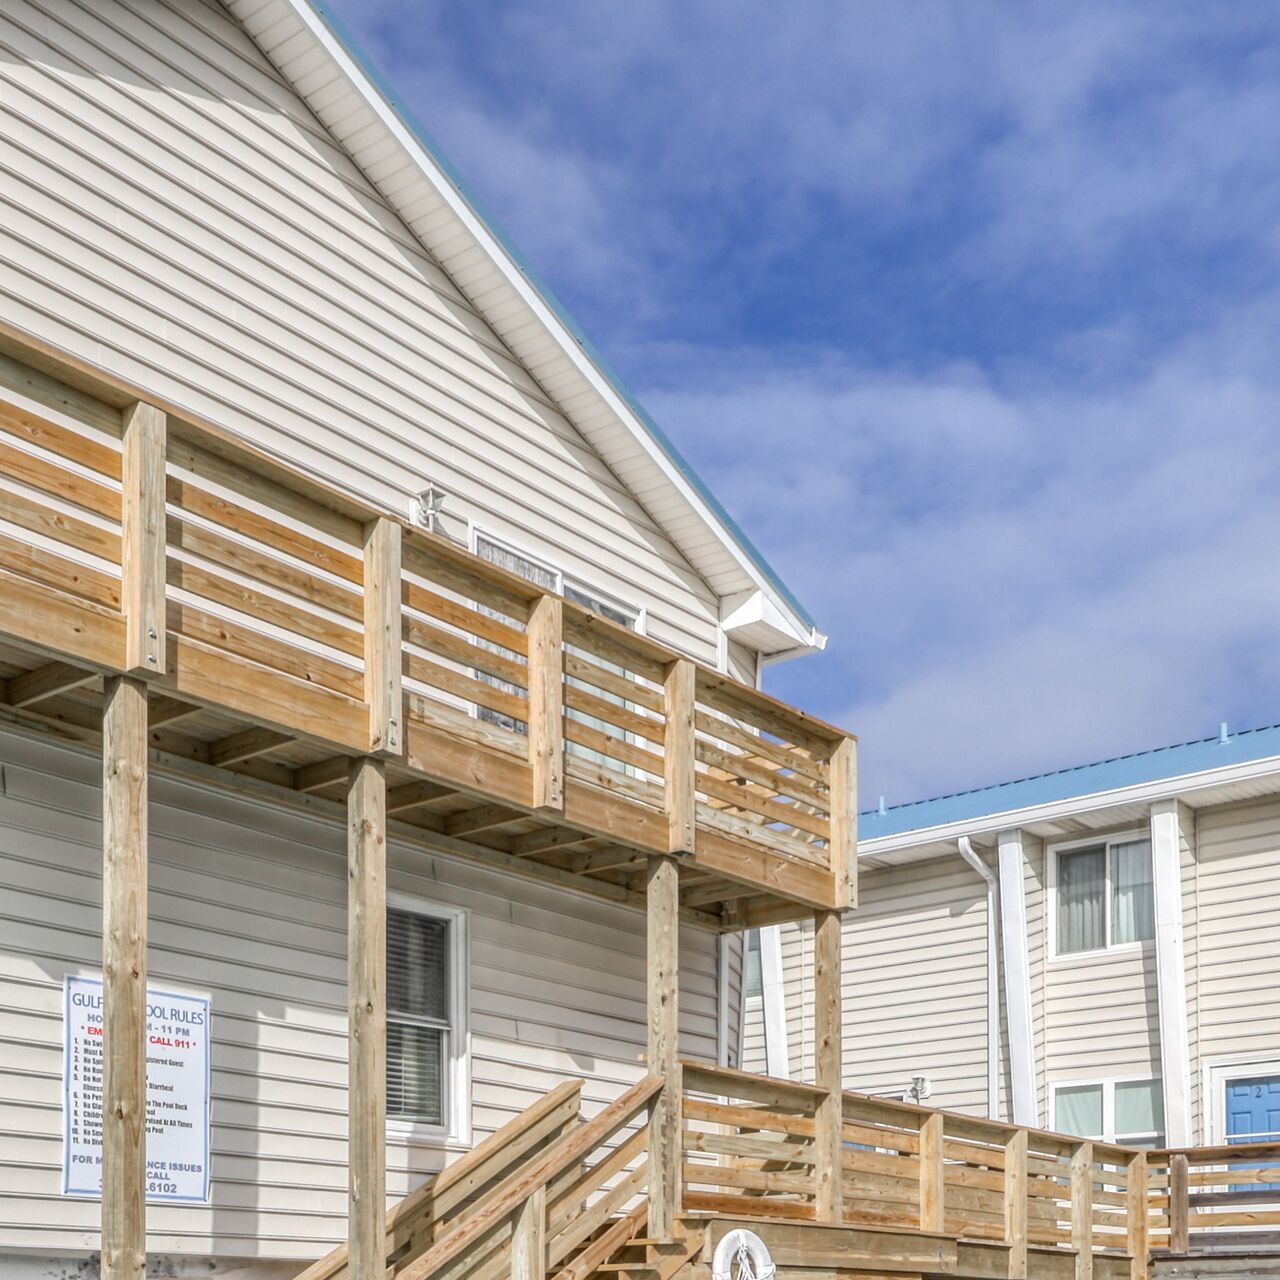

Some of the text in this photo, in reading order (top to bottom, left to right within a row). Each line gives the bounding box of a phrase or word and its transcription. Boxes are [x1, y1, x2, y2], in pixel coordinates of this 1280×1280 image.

[146, 1005, 168, 1020] OOL
[170, 1008, 204, 1025] RULES
[161, 1025, 172, 1034] 11
[175, 1027, 190, 1036] PM
[150, 1036, 190, 1049] CALL 911
[1255, 1086, 1262, 1098] 2
[72, 1155, 93, 1164] FOR
[169, 1162, 202, 1173] ISSUES
[147, 1171, 170, 1181] CALL
